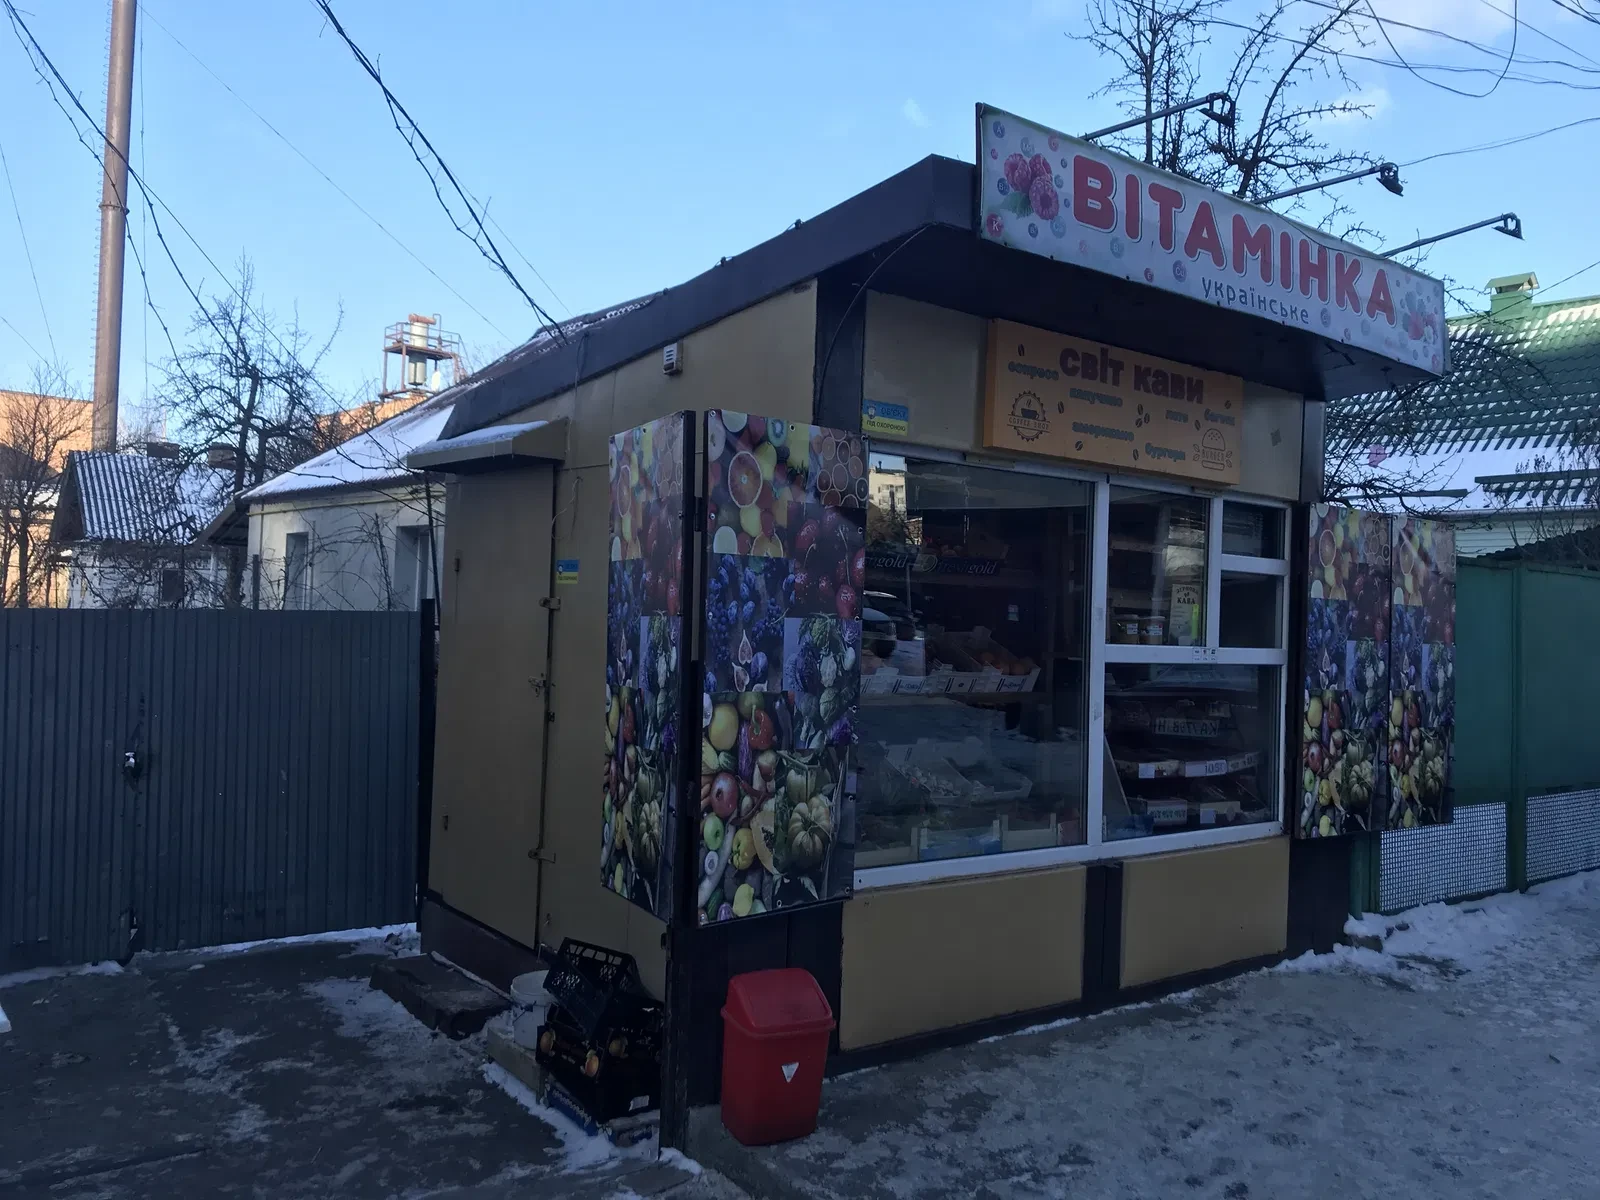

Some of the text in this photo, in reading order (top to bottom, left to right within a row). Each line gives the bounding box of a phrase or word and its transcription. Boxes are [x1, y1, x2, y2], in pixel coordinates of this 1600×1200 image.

[1073, 154, 1398, 327] ВІТАМІНКА
[1202, 276, 1310, 325] українське
[1133, 363, 1204, 405] кави
[1008, 416, 1031, 427] COFFEE
[1202, 449, 1225, 461] BURGER
